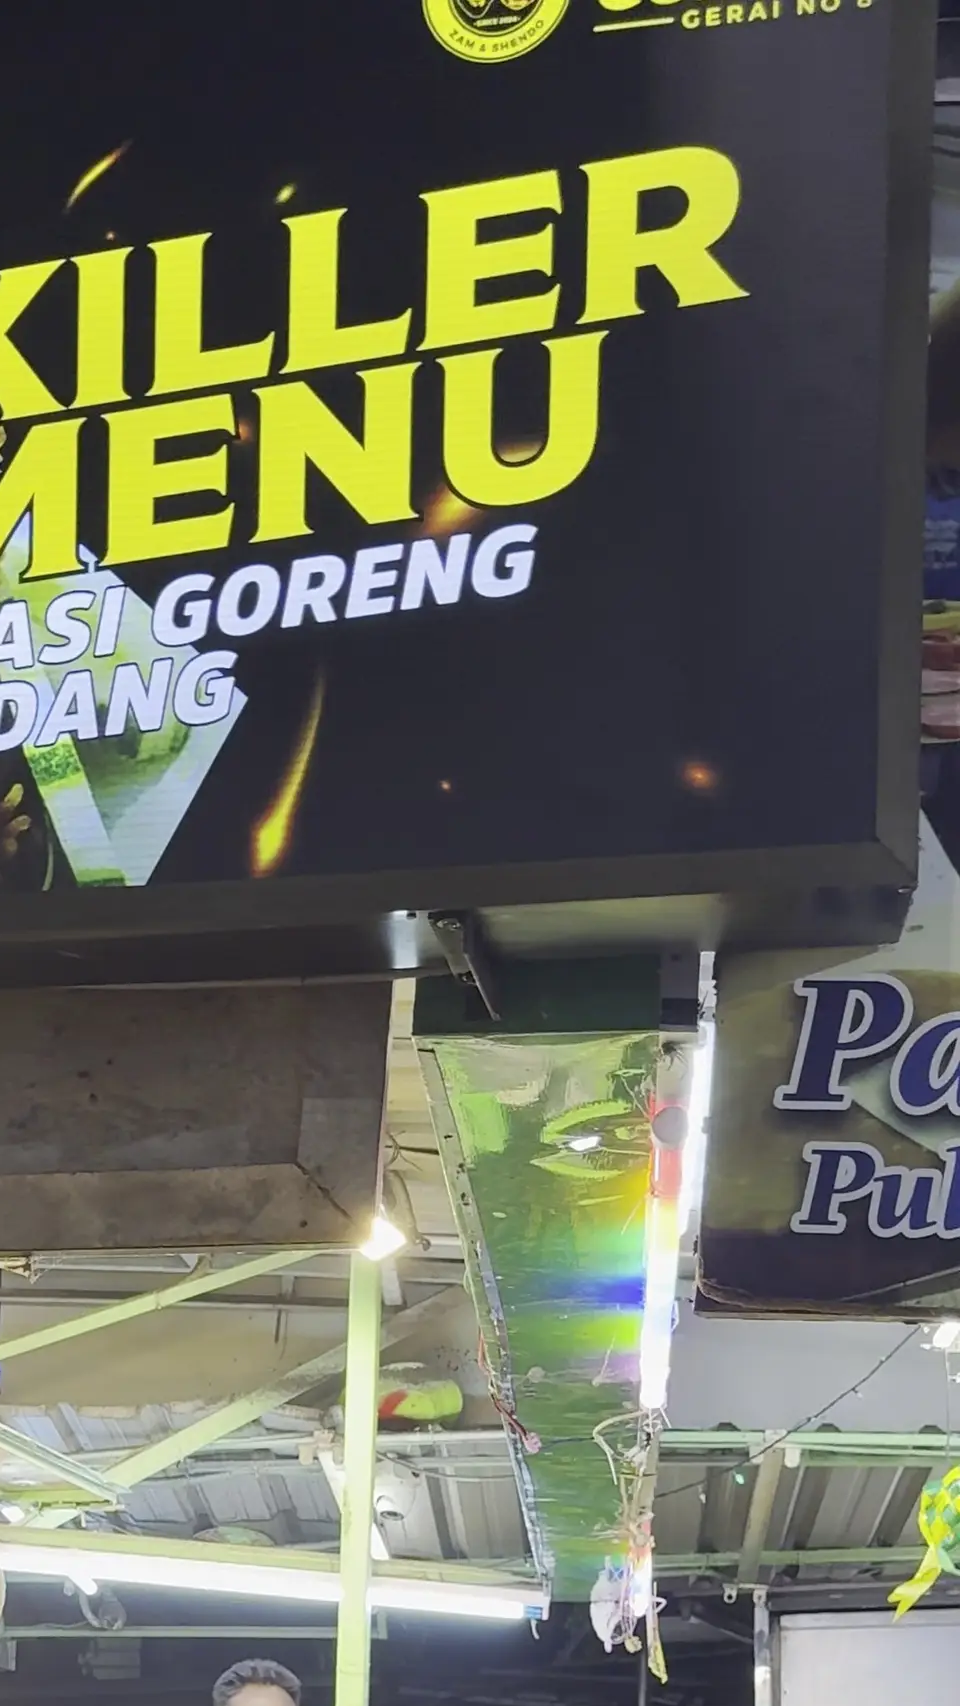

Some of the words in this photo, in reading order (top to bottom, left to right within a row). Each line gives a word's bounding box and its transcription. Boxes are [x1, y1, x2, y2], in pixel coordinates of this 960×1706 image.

[681, 0, 781, 29] GERAI
[448, 28, 475, 49] ZAM
[150, 523, 539, 648] GORENG
